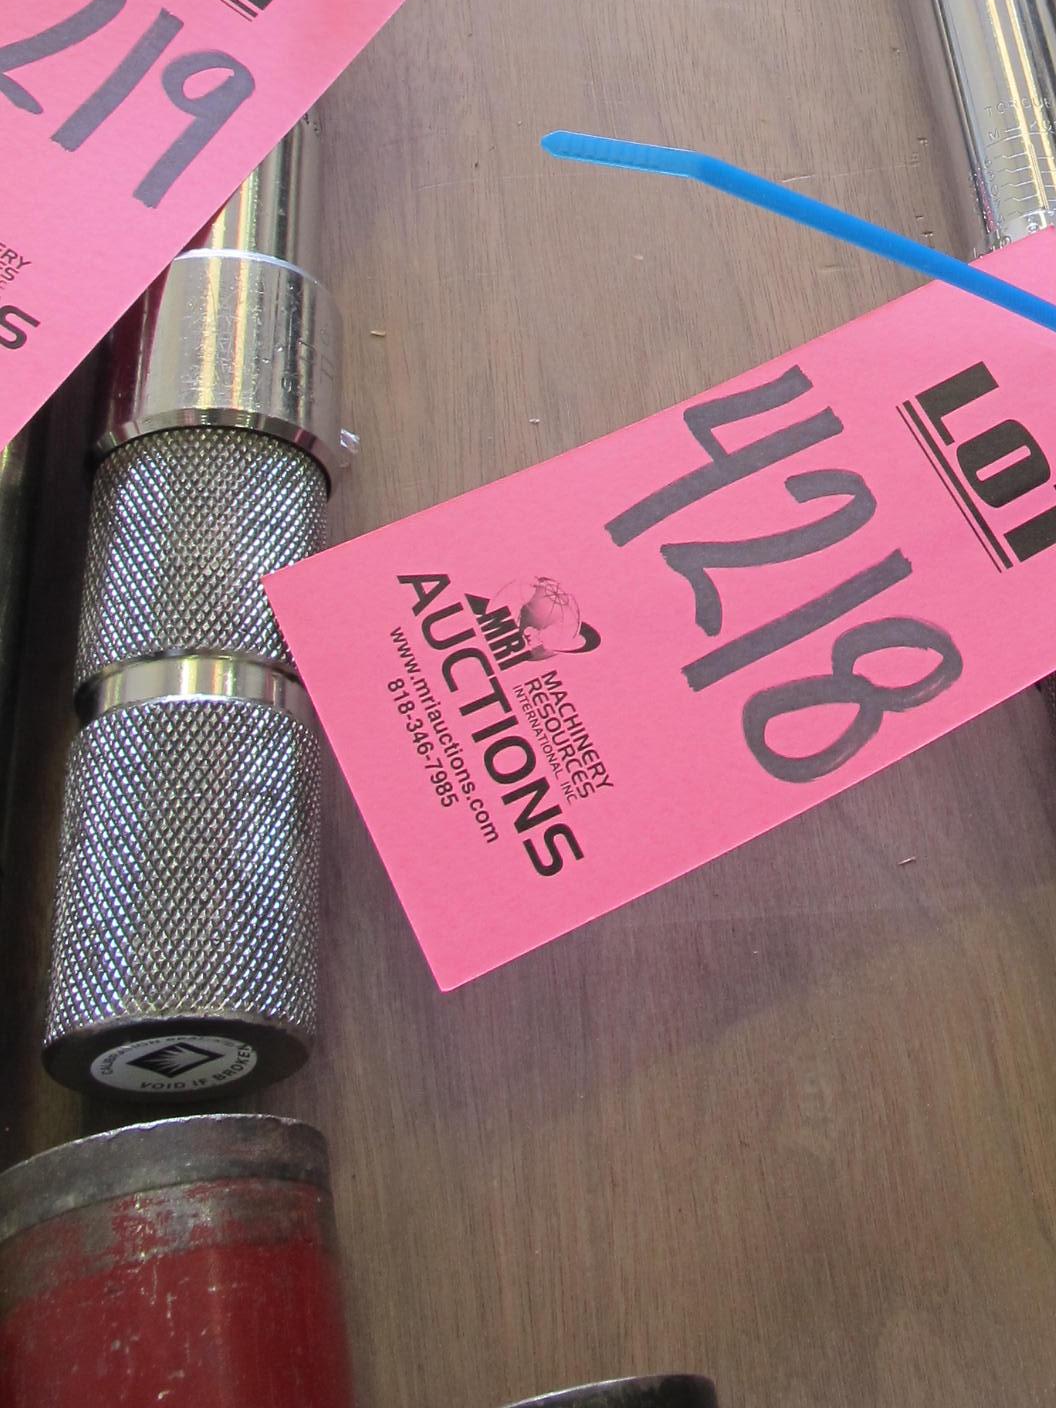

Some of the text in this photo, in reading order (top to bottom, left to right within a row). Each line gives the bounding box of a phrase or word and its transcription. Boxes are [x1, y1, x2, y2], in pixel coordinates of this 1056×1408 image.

[604, 364, 964, 783] 4218
[476, 605, 534, 671] MRI
[387, 677, 459, 808] 818-346-7985
[389, 626, 500, 843] www.mriauctions.com
[396, 573, 585, 877] AUCTIONS
[512, 684, 578, 806] INTERNATIONAL INC
[524, 677, 596, 799] RESOURCES
[541, 669, 614, 790] MACHINERY
[140, 1043, 253, 1089] VOID IF BROKEN
